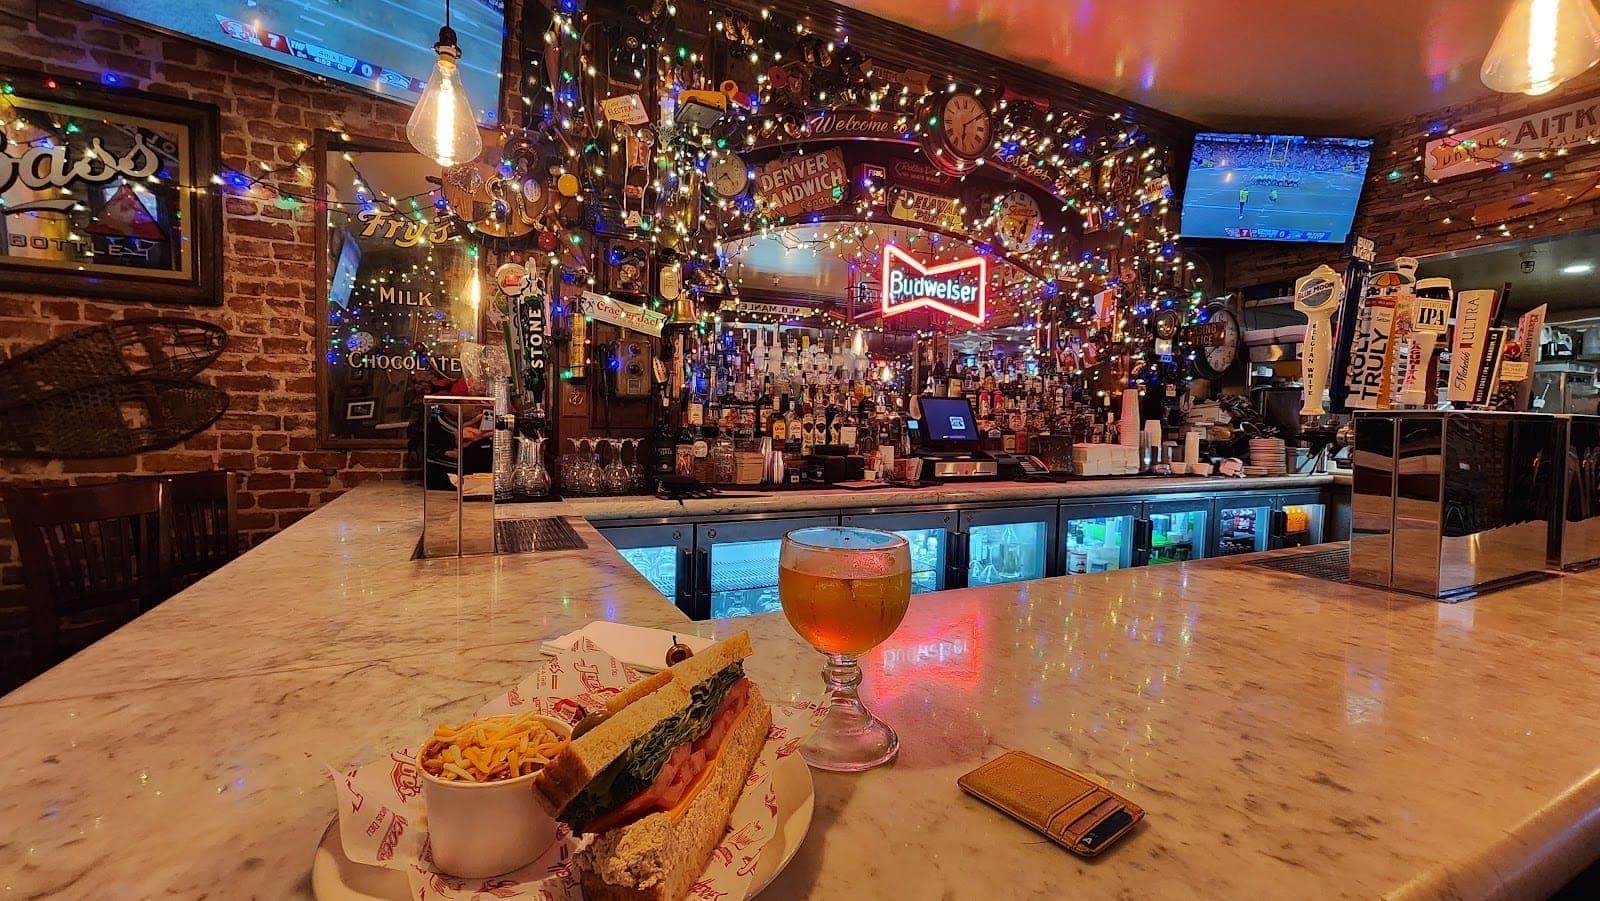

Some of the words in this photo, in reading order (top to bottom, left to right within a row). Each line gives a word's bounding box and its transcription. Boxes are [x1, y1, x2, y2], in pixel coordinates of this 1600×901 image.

[267, 33, 281, 48] 7
[361, 63, 373, 77] 0
[810, 114, 889, 134] Welcome
[0, 133, 159, 193] ass
[761, 153, 830, 192] DENVER
[756, 168, 843, 211] ANDWICH
[1357, 236, 1375, 250] BUD
[380, 286, 433, 307] MILK
[890, 270, 978, 303] Budweiser
[1297, 288, 1313, 300] BLUE
[1312, 280, 1335, 294] MOON
[596, 300, 634, 319] Cracer
[1418, 307, 1445, 325] IPA
[1461, 297, 1479, 341] ULTRA
[529, 308, 544, 369] STONE
[1308, 323, 1317, 364] BELGIAN
[1361, 328, 1388, 400] TRULY
[1455, 351, 1471, 392] Michelob
[1307, 367, 1315, 396] WHITE
